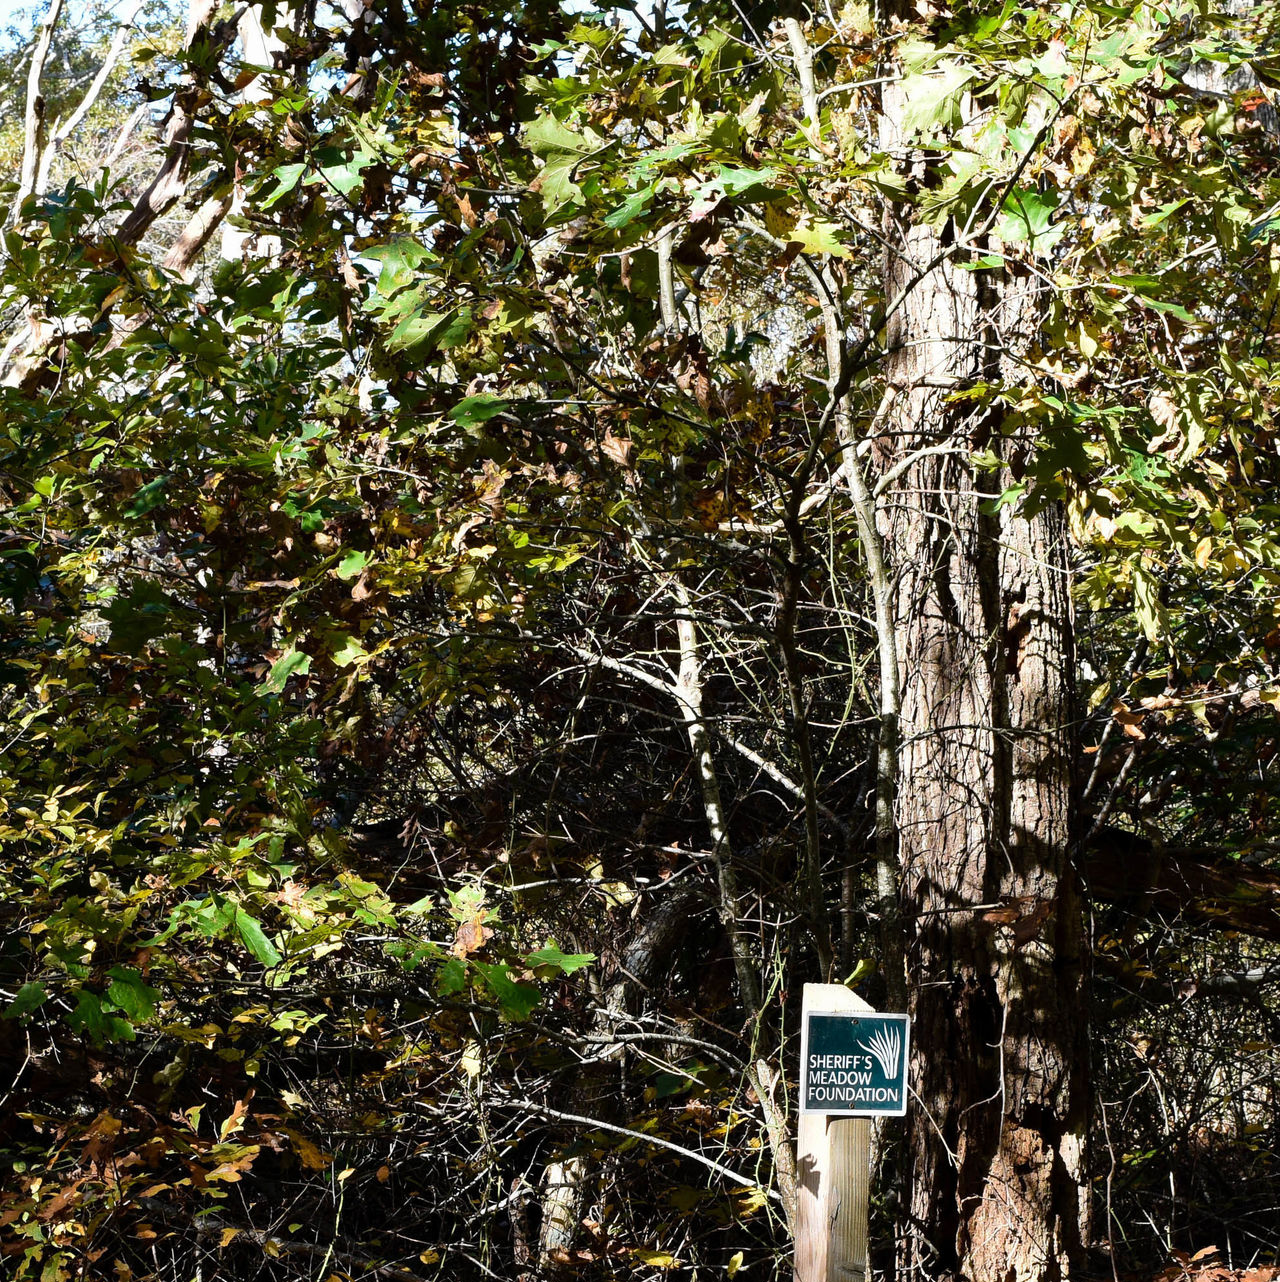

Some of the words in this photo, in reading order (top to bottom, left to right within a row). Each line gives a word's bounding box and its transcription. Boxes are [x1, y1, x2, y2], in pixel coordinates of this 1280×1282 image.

[809, 1054, 872, 1070] SHERIFF'S
[809, 1071, 872, 1085] MEADOW
[808, 1087, 898, 1102] FOUNDATION
